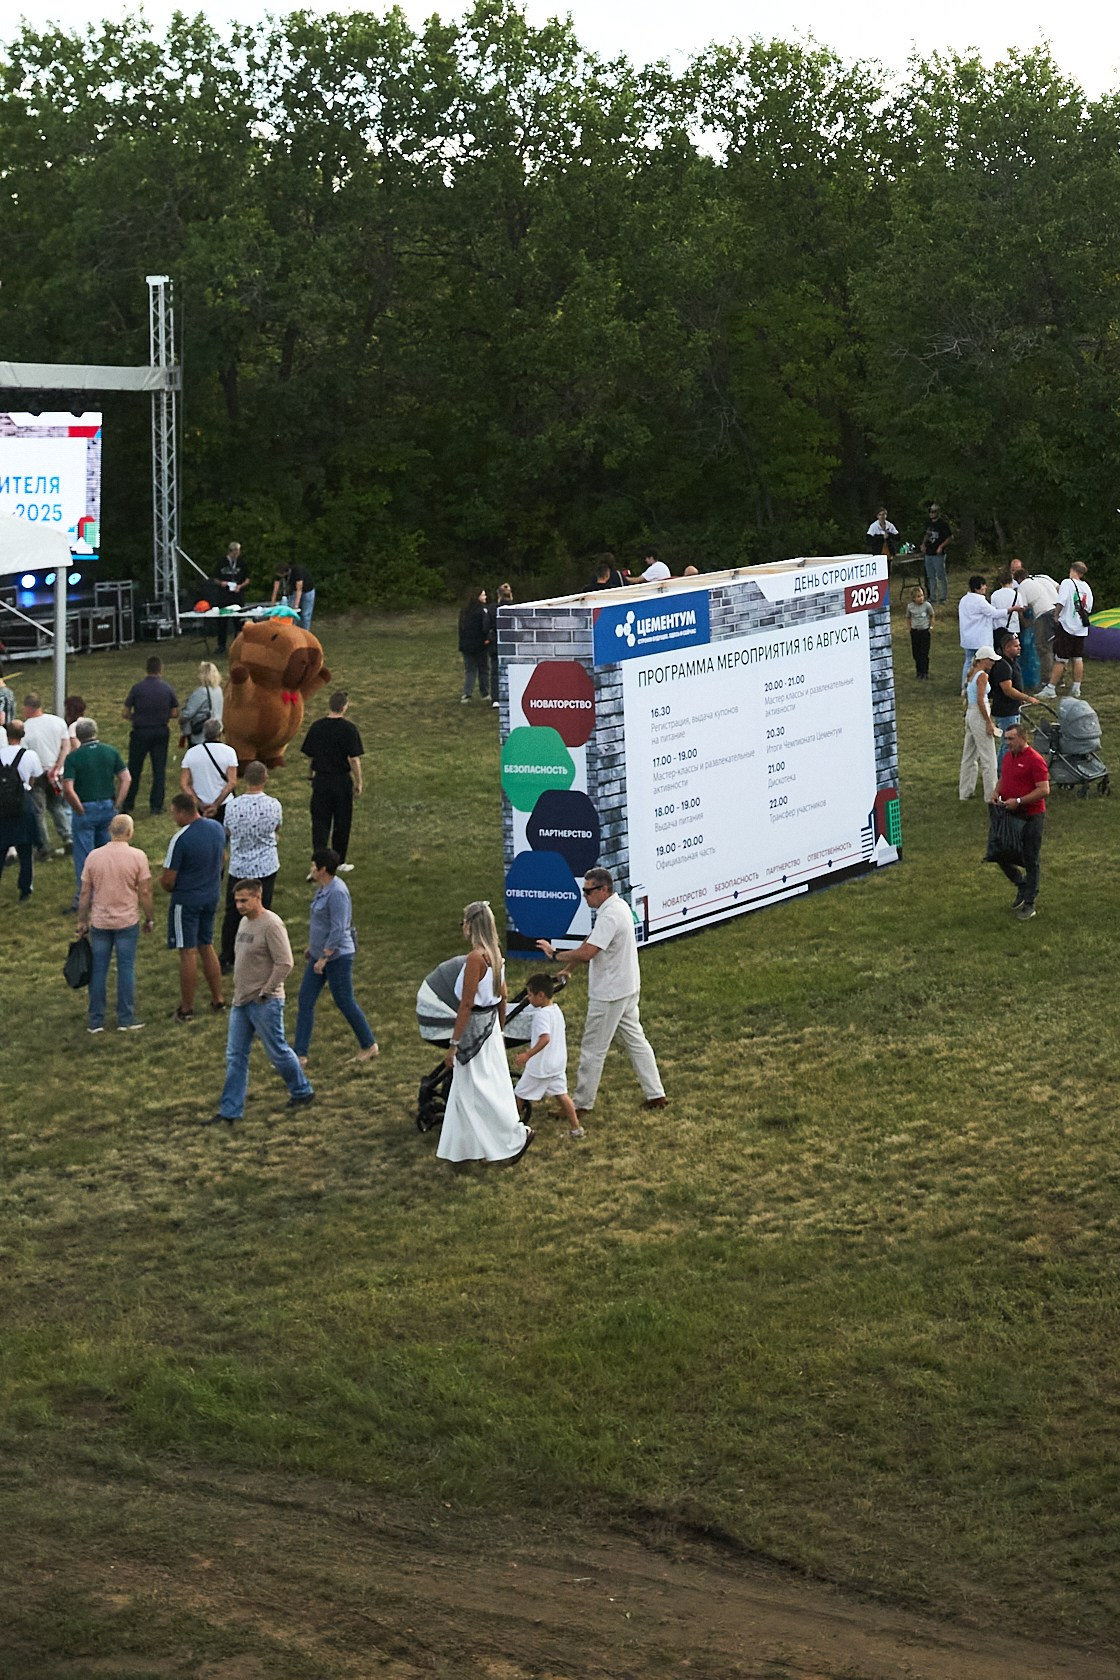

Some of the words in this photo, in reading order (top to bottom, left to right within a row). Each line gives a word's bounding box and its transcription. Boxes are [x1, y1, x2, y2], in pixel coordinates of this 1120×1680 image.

[16, 504, 63, 522] 2025
[794, 573, 820, 594] ДЕНЬ
[821, 562, 877, 586] СТРОИТЕЛЯ
[851, 585, 880, 608] 2025
[637, 609, 697, 637] ЦЕМЕНТУМ
[638, 657, 715, 688] ПРОГРАММА
[717, 638, 800, 671] МЕРОПРИЯТИЯ
[802, 635, 814, 652] 16
[816, 625, 860, 650] АВГУСТА
[764, 679, 784, 692] 20.00
[788, 674, 805, 687] 21.00
[530, 699, 593, 709] НОВАТОРСТВО
[764, 692, 785, 705] Мастер
[650, 705, 671, 719] 16.30
[766, 726, 785, 740] 20.30
[651, 736, 660, 745] на
[652, 754, 672, 768] 17.00
[678, 748, 698, 761] 19.00
[504, 764, 568, 775] БЕЗОПАСНОСТЬ
[768, 761, 786, 774] 21.00
[653, 780, 689, 795] активности
[654, 804, 675, 818] 18.00
[681, 797, 701, 811] 19.00
[769, 795, 788, 809] 22.00
[654, 820, 678, 832] Выдача
[538, 828, 593, 839] ПАРТНЕРСТВО
[656, 842, 676, 857] 19.00
[682, 834, 704, 849] 20.00
[662, 887, 708, 909] НОВАТОРСТВО
[714, 872, 760, 893] БЕЗОПАСНОСТЬ
[765, 858, 801, 876] ПАРТНЕРСТВО
[807, 841, 852, 863] ОТВЕТСТВЕННОСТЬ
[505, 889, 578, 900] ОТВЕТСТВЕННОСТЬ
